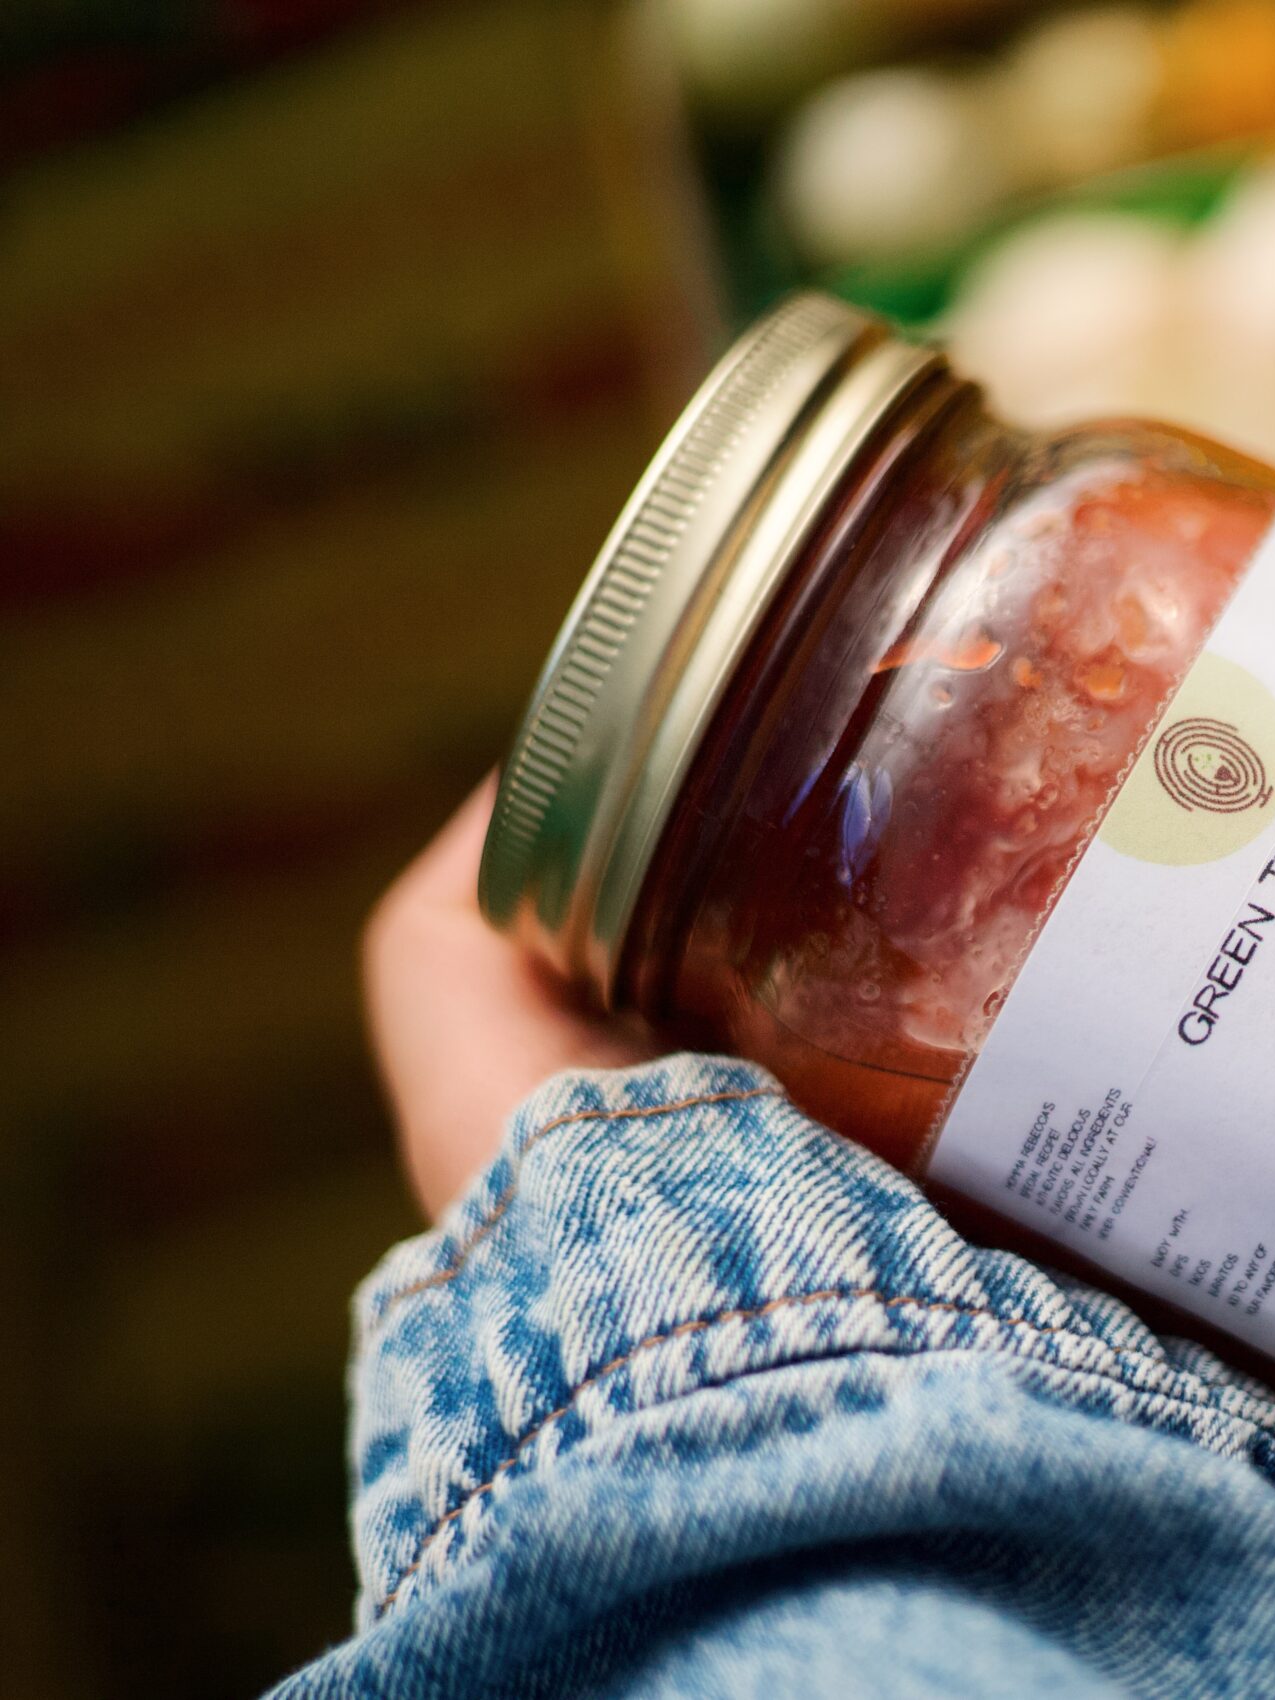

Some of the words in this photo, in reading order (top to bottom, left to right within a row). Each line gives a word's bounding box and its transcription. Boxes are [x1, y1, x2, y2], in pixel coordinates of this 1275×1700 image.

[1177, 903, 1275, 1045] GREEN
[1056, 1108, 1092, 1161] DELICIOUS
[1070, 1160, 1086, 1177] ALL
[1079, 1087, 1122, 1158] INGREDIENTS
[1081, 1144, 1110, 1192] LOCALLY
[1105, 1128, 1119, 1146] AT
[1112, 1101, 1134, 1128] OUR
[1092, 1175, 1116, 1205] FARM
[1232, 1279, 1249, 1294] TO
[1244, 1258, 1260, 1281] ANY
[1253, 1242, 1268, 1260] OF
